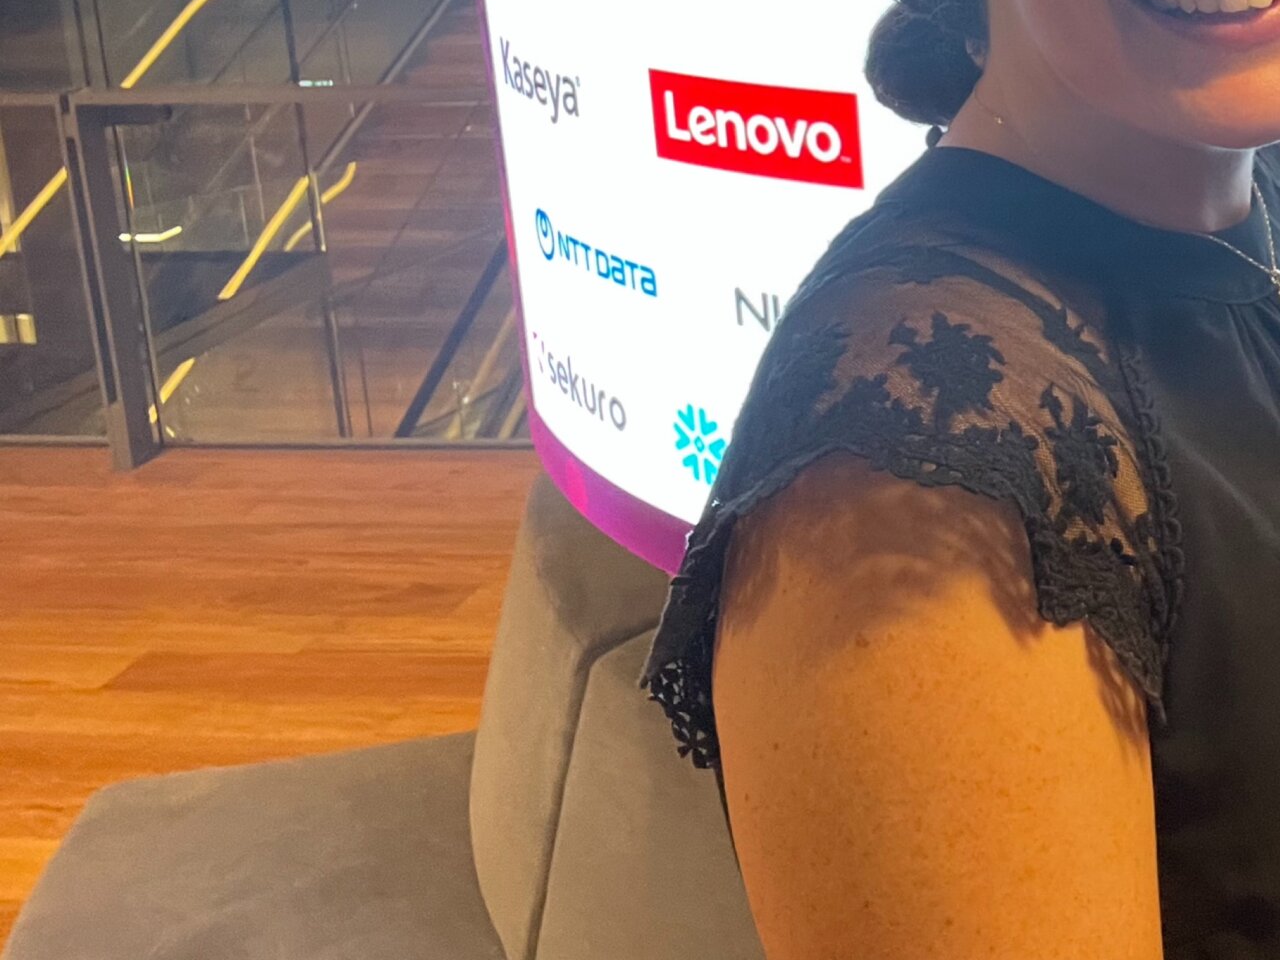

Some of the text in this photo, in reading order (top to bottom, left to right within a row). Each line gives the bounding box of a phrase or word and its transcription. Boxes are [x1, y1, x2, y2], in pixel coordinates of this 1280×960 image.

[500, 36, 580, 124] Kaseya
[664, 90, 842, 163] Lenovo
[557, 230, 591, 272] NTT
[548, 351, 627, 431] sekuro
